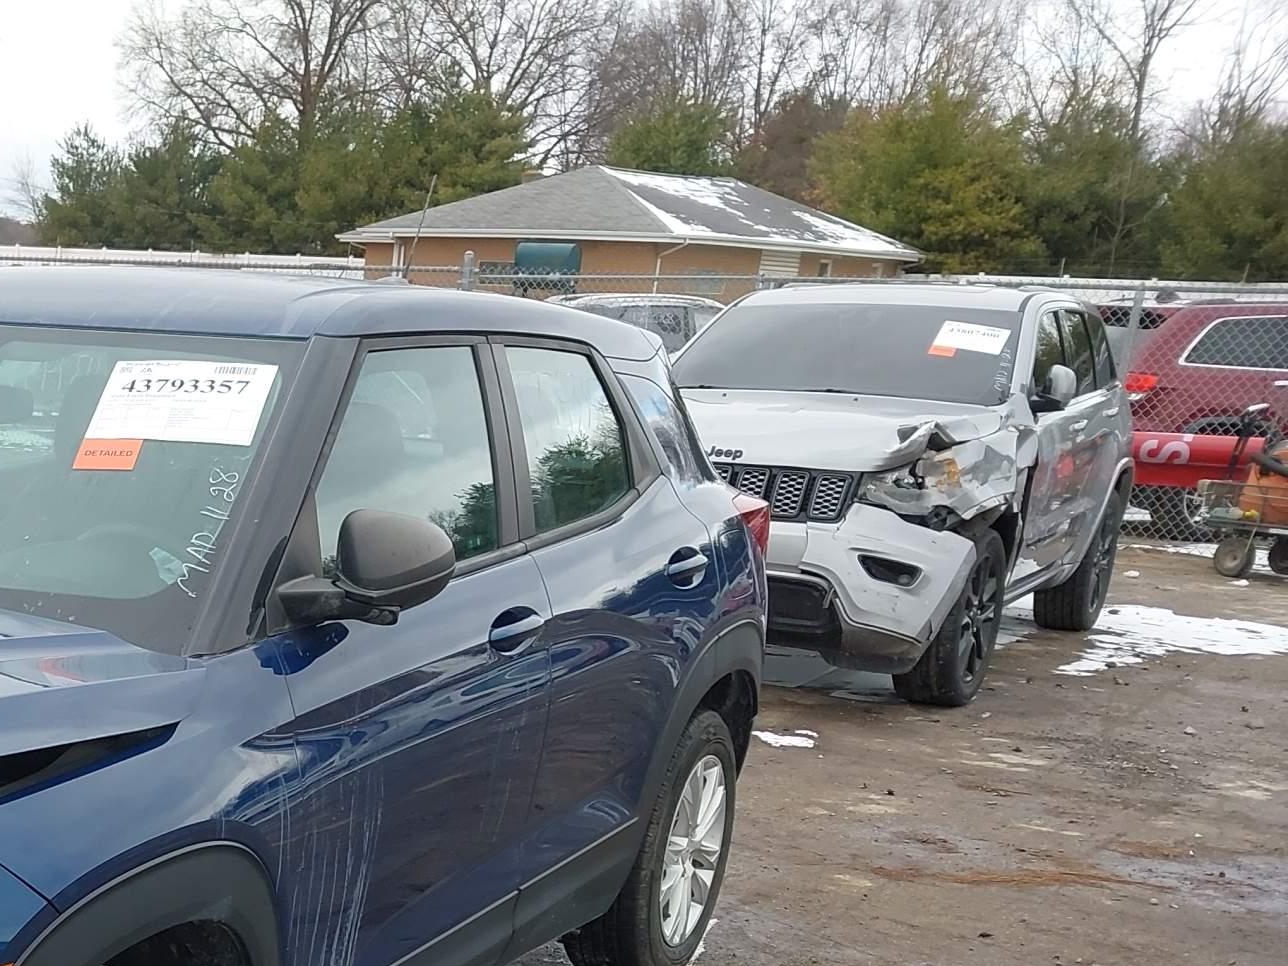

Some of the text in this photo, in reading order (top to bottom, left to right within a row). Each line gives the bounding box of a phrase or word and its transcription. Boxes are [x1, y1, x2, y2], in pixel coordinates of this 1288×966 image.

[122, 378, 251, 395] 43793357
[84, 449, 134, 457] DETAILED
[707, 445, 744, 461] Jeep
[176, 531, 217, 599] MAD
